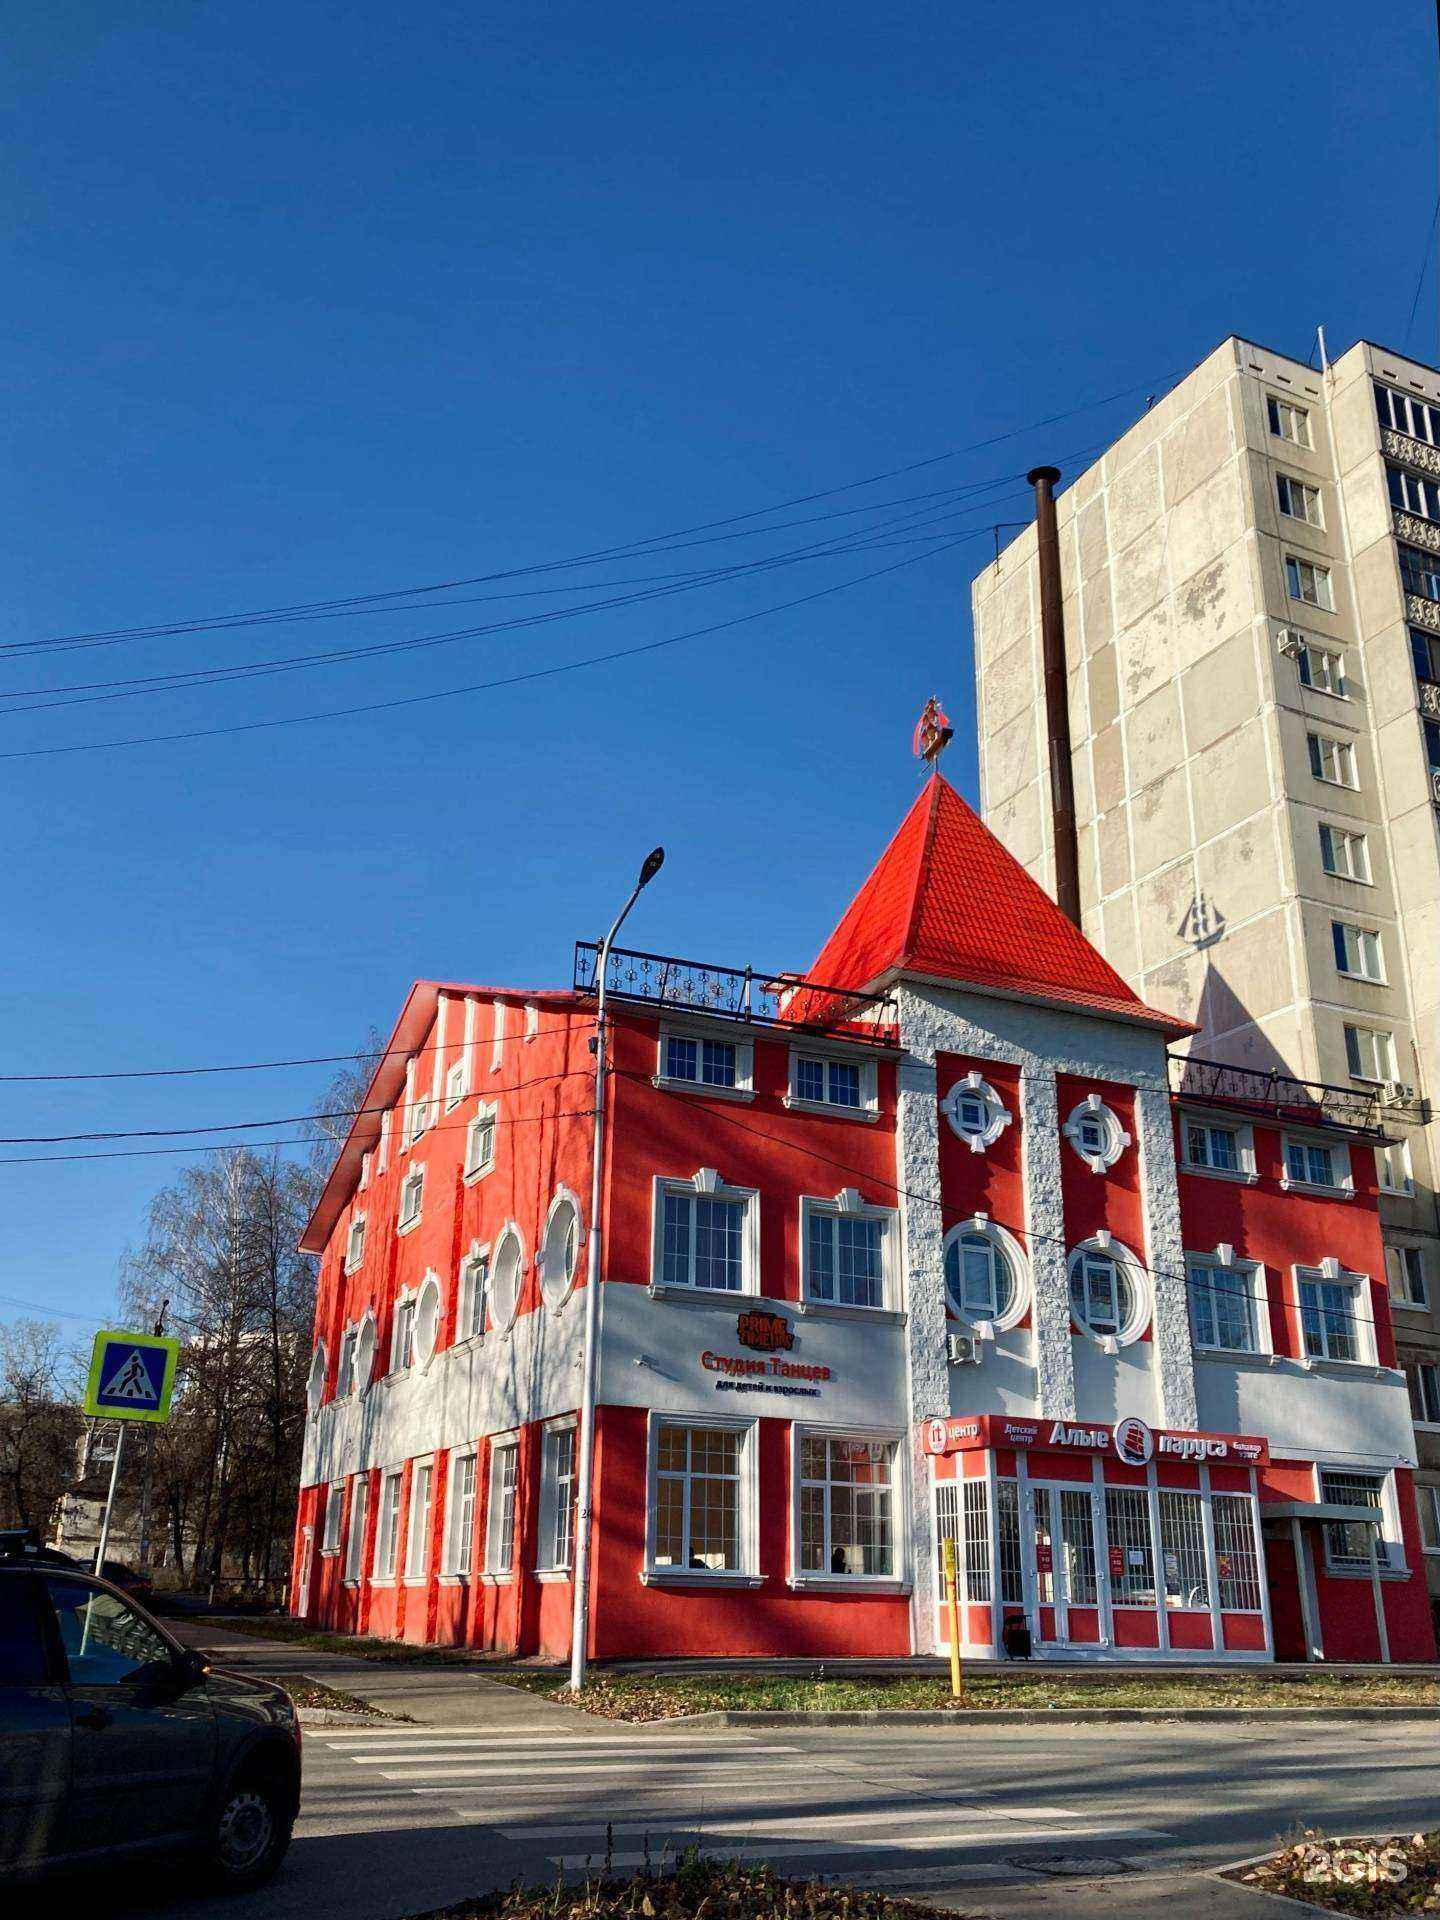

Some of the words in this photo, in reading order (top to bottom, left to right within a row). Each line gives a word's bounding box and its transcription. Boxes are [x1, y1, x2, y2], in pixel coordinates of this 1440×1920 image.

[700, 1351, 766, 1377] Студия
[769, 1357, 831, 1381] Танцев
[715, 1380, 734, 1391] для
[735, 1381, 764, 1393] детей
[773, 1385, 818, 1397] взрослых
[948, 1423, 979, 1441] центр
[1004, 1423, 1039, 1435] Детский
[1010, 1434, 1034, 1445] центр
[1049, 1422, 1109, 1449] Алые
[1158, 1435, 1227, 1461] паруса
